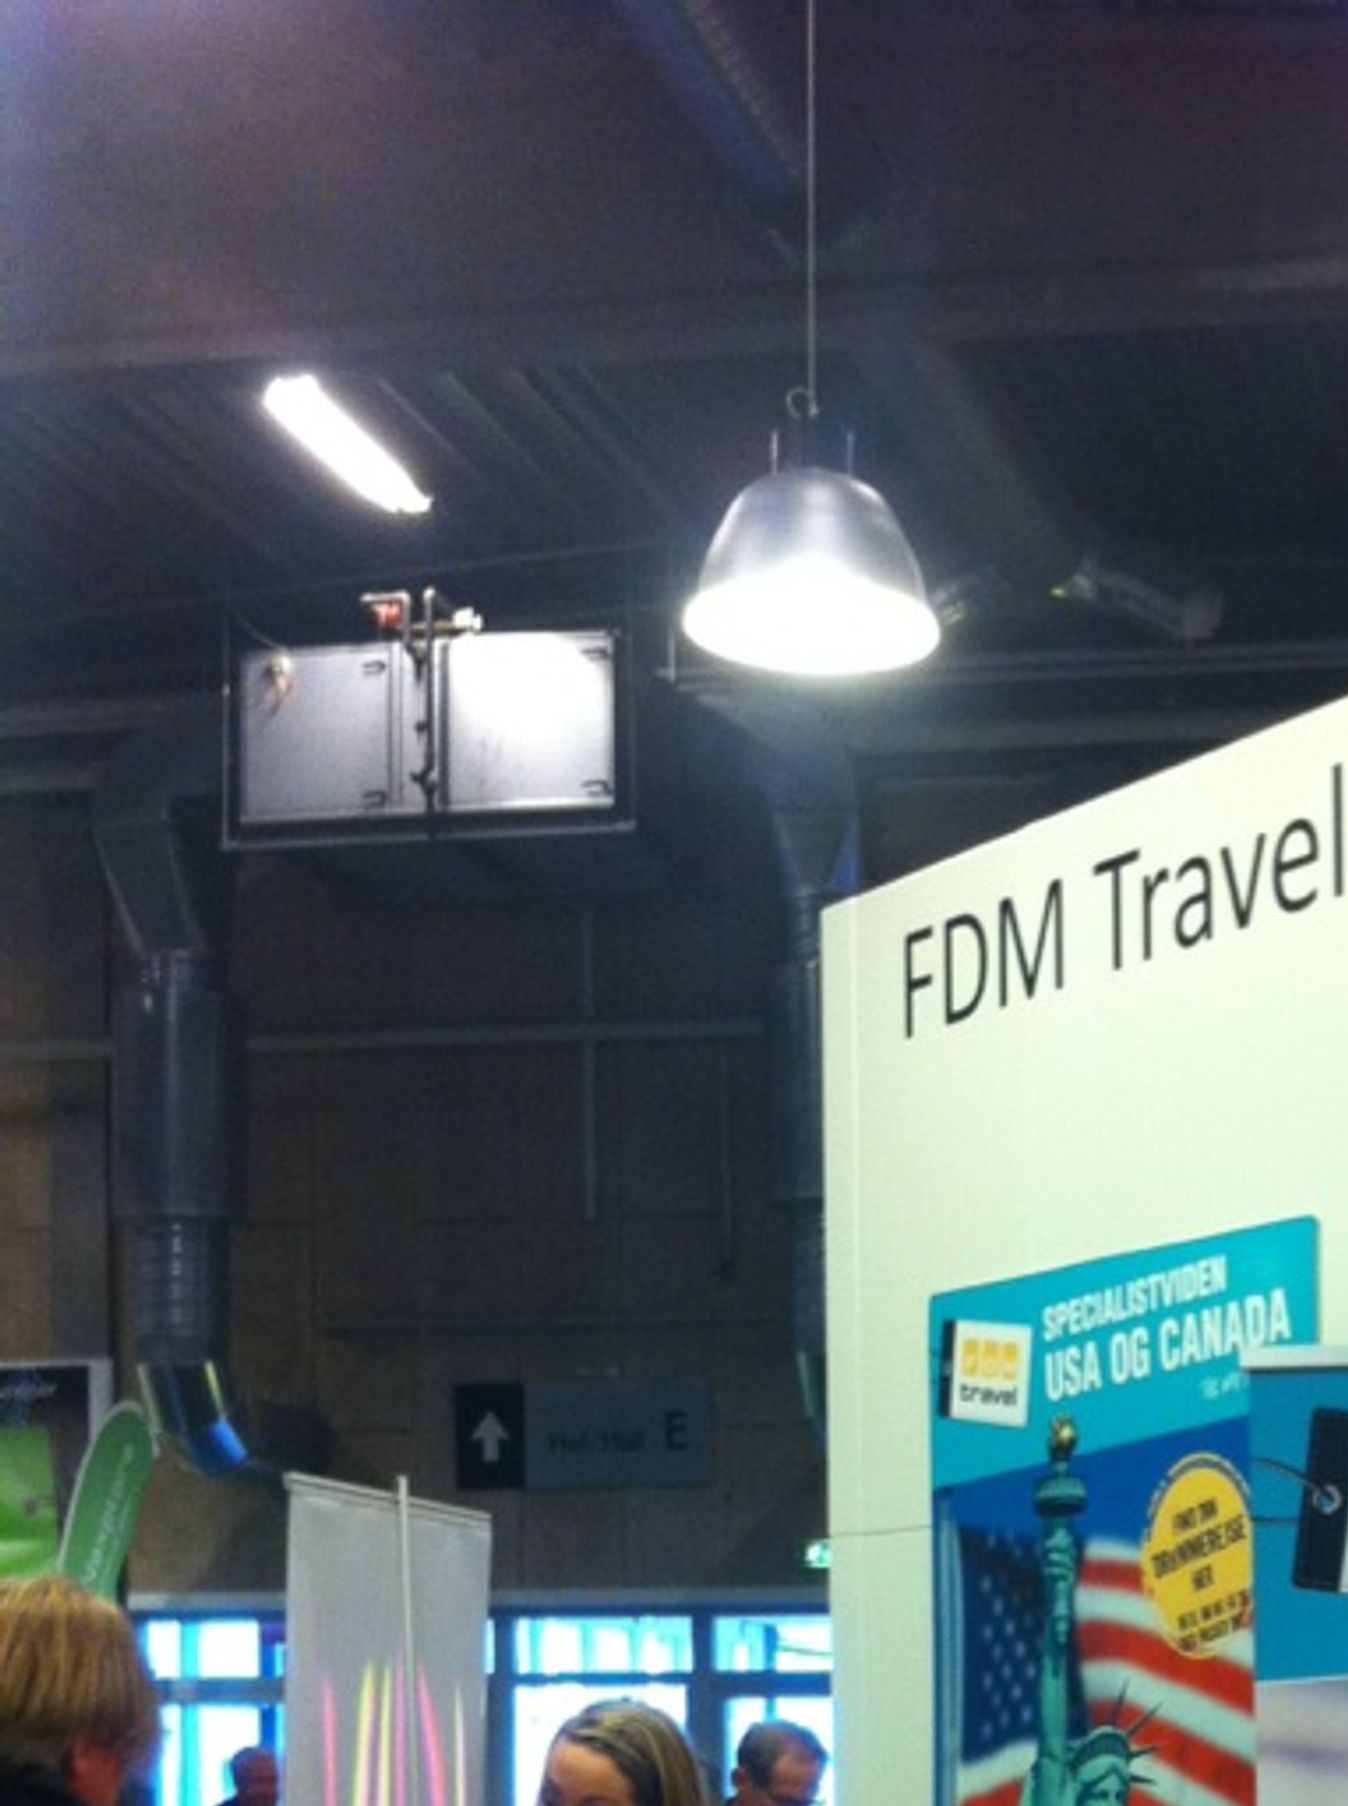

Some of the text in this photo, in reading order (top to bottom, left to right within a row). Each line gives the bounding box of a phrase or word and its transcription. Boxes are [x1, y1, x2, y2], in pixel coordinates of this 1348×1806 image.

[901, 763, 1348, 1042] FDM Travel
[1042, 1255, 1227, 1342] SPECIALISTVIDEN
[1043, 1339, 1103, 1402] USA
[1109, 1325, 1152, 1386] OG
[1158, 1287, 1293, 1371] CANADA
[664, 1411, 689, 1451] E
[957, 1383, 1020, 1407] travel
